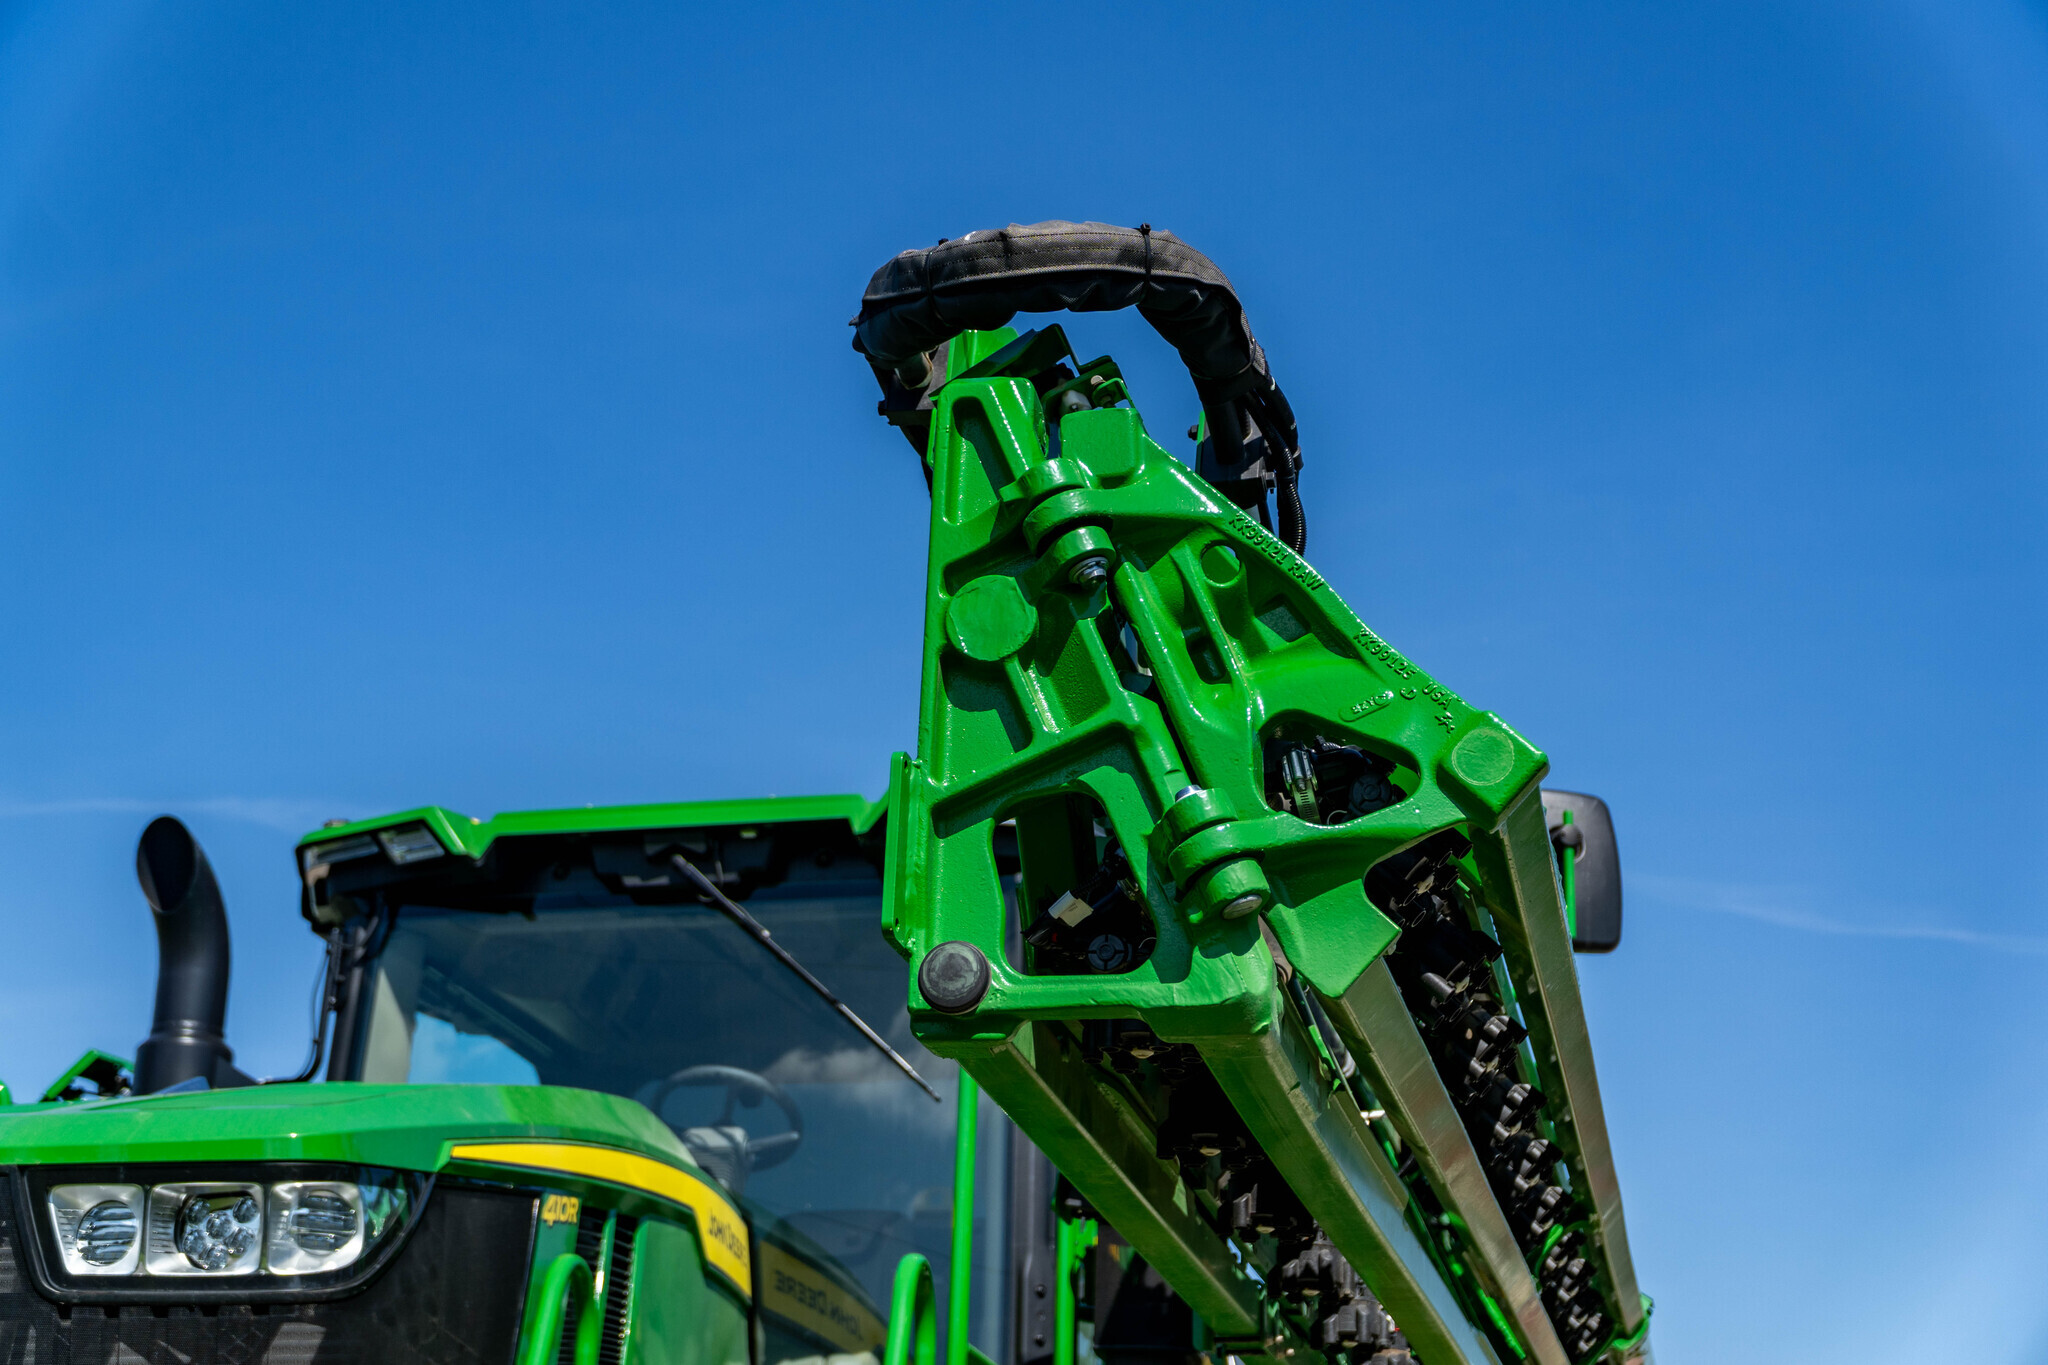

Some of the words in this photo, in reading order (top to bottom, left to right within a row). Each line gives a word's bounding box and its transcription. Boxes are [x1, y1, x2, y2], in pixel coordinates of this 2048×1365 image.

[1229, 512, 1288, 565] KK99121
[1288, 560, 1323, 590] RAW
[1353, 628, 1416, 680] KK99125
[1422, 681, 1453, 710] USA
[542, 1194, 579, 1226] 410R
